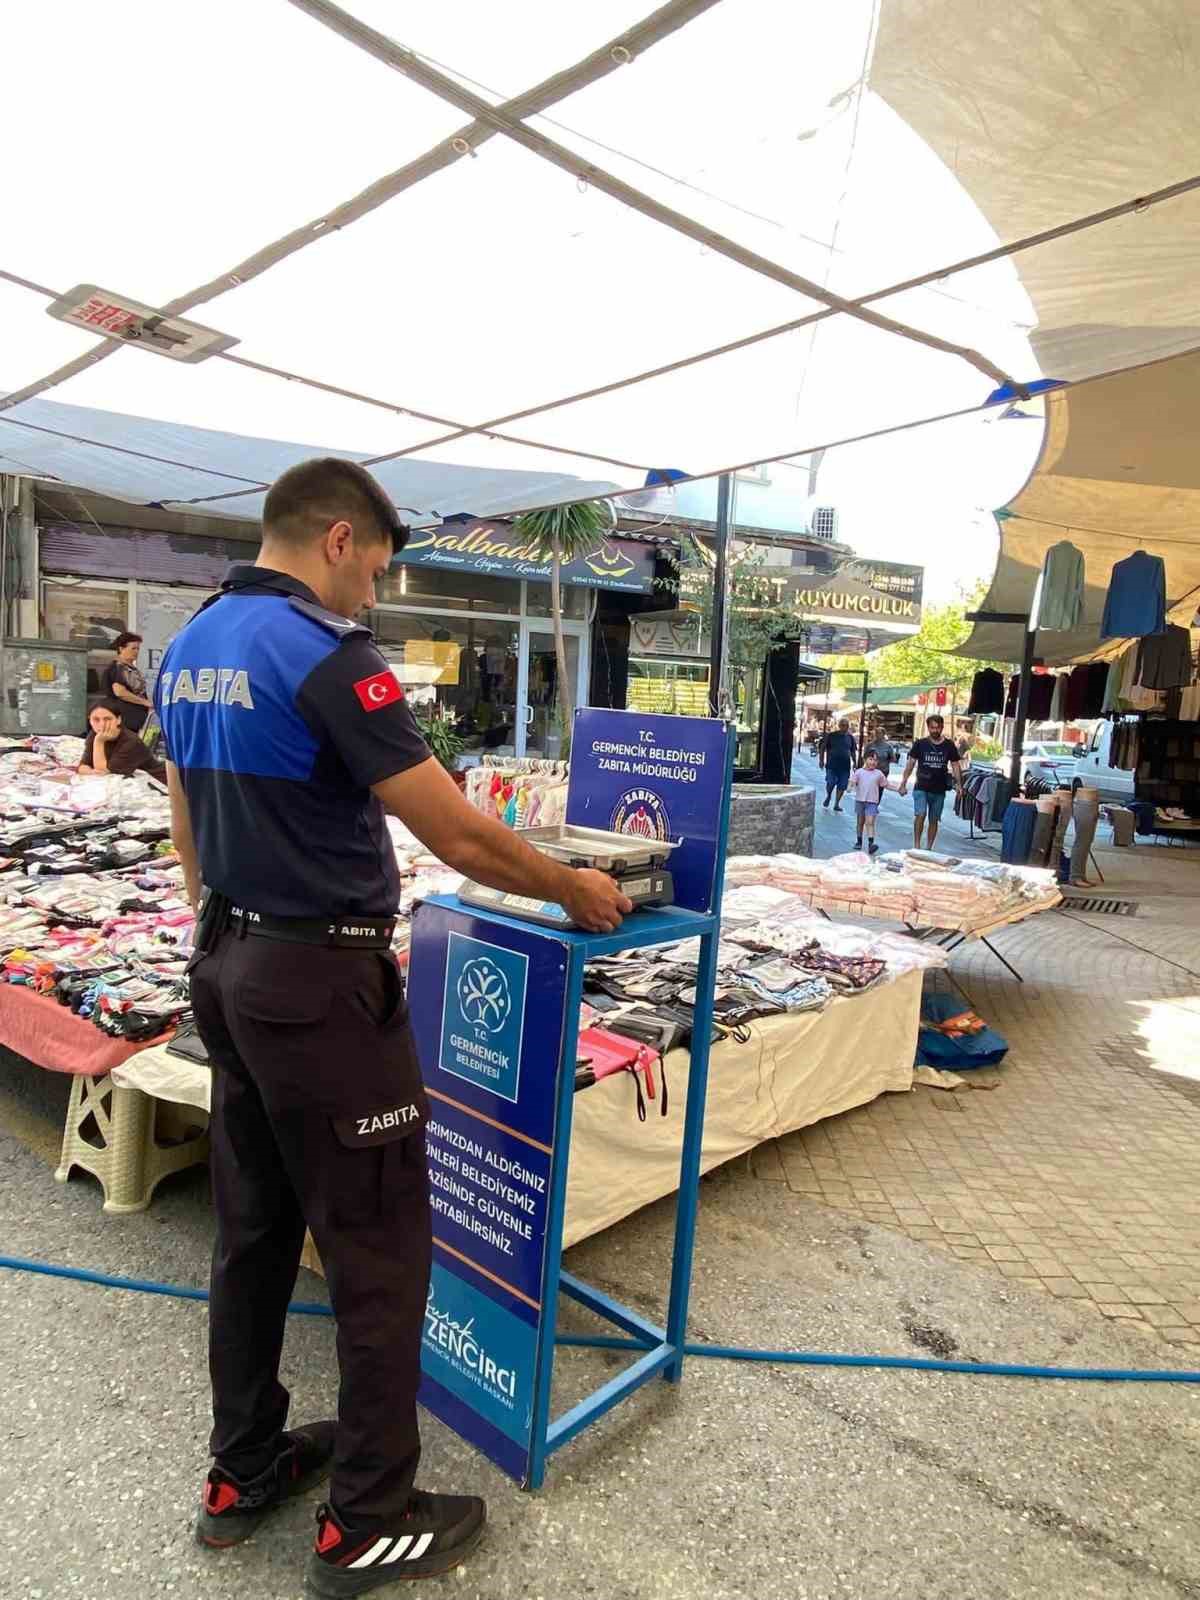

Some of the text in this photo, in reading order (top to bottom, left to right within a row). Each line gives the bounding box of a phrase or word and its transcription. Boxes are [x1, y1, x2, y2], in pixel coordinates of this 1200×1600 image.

[794, 588, 914, 617] KUYUMCULUK
[639, 731, 656, 743] T.C.
[592, 741, 706, 765] GERMENCİK BELEDİYESİ
[598, 758, 697, 783] ZABITA MÜDÜRLÜĞÜ
[625, 790, 661, 810] ZABITA
[474, 1028, 489, 1041] T.C.
[450, 1034, 510, 1069] GERMENCİK
[456, 1052, 501, 1080] BELEDİYESİ
[356, 1104, 420, 1135] ZABITA
[485, 1151, 546, 1193] ALDIĞINIZ
[461, 1160, 536, 1215] BELEDİYEMİZ
[429, 1193, 514, 1256] ARTABİLİRSİNİZ.
[477, 1198, 532, 1240] GÜVENLE
[426, 1313, 516, 1398] ZENCİRCİ
